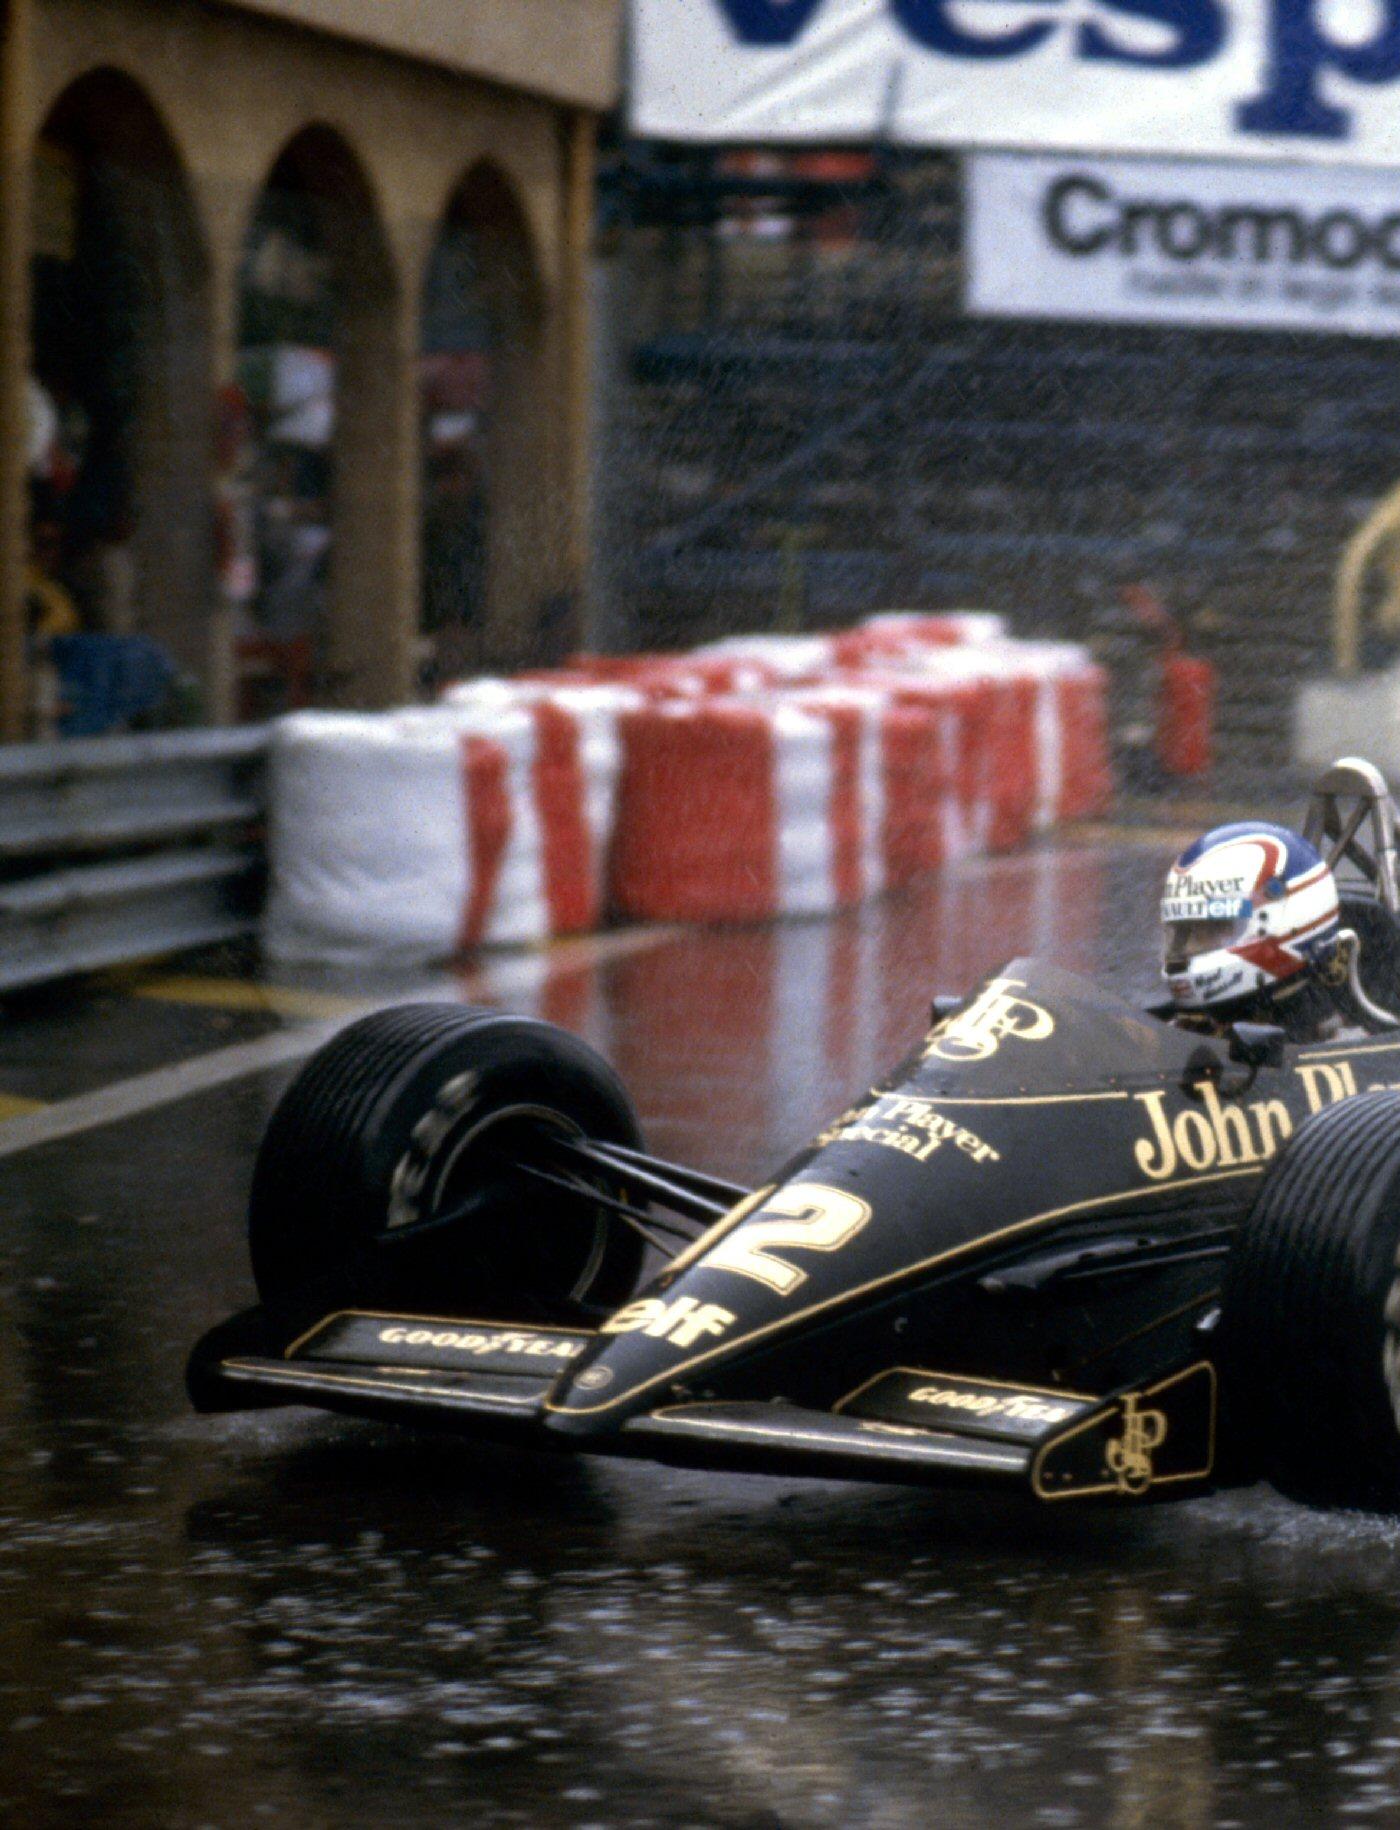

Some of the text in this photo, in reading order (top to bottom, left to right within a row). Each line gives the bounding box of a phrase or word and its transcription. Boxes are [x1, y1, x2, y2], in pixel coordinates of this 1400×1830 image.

[882, 1101, 1001, 1164] Player
[1134, 1080, 1293, 1180] John
[697, 1182, 874, 1297] 2
[600, 1296, 738, 1348] elf
